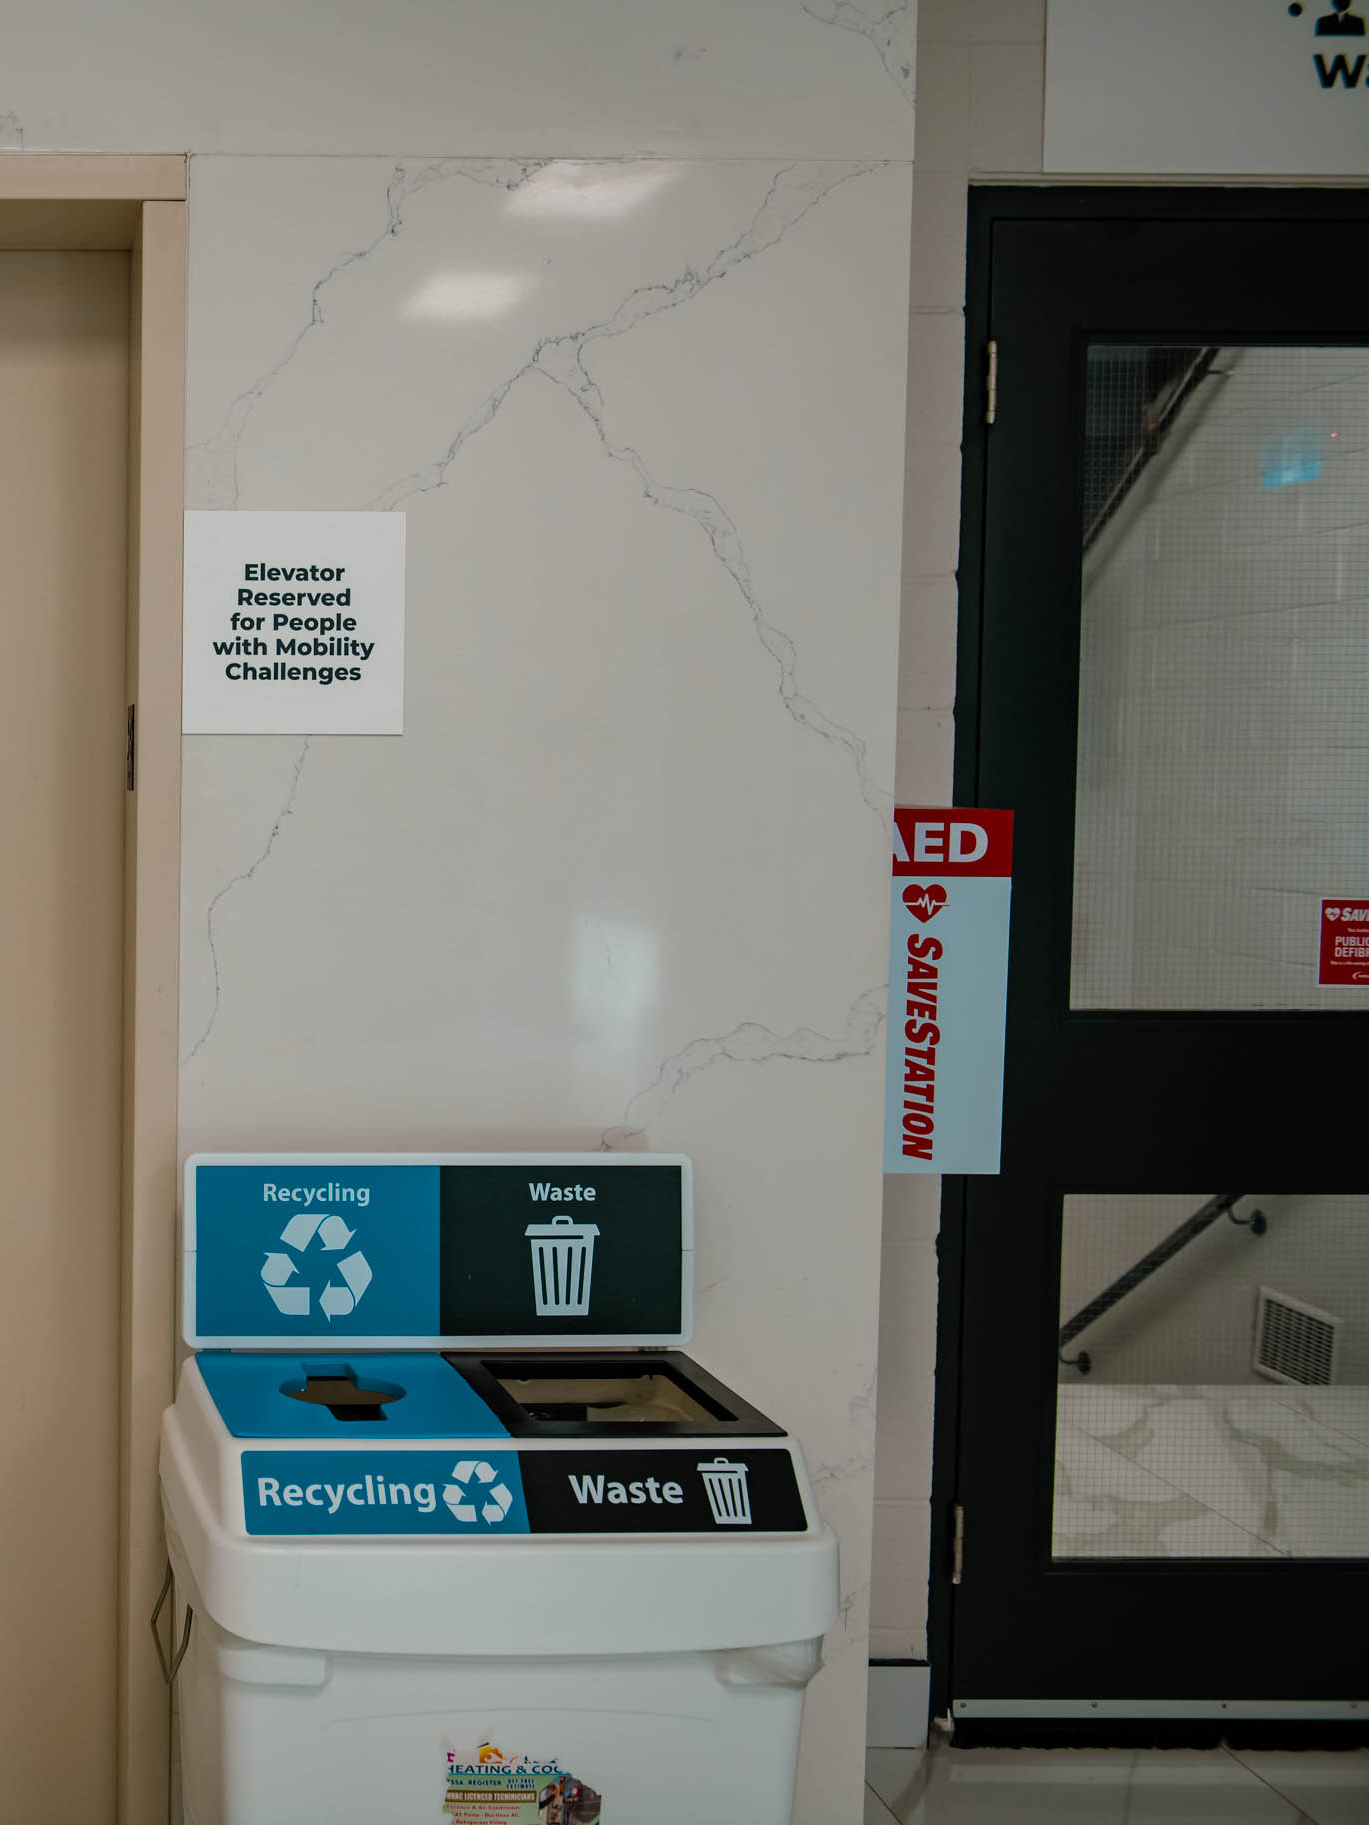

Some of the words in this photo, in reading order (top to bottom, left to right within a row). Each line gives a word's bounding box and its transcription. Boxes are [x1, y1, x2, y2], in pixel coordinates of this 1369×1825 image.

[1312, 54, 1369, 88] W
[244, 563, 345, 582] Elevator
[237, 588, 351, 606] Reserved
[230, 612, 265, 631] for
[273, 613, 357, 635] People
[213, 636, 267, 656] with
[276, 636, 375, 660] Mobility
[225, 662, 362, 685] Challenges
[902, 933, 943, 1161] SAVESTATION
[263, 1182, 370, 1207] Recycling
[529, 1182, 597, 1202] Waste
[257, 1475, 438, 1513] Recycling
[568, 1475, 684, 1504] Waste
[516, 1765, 527, 1774] &
